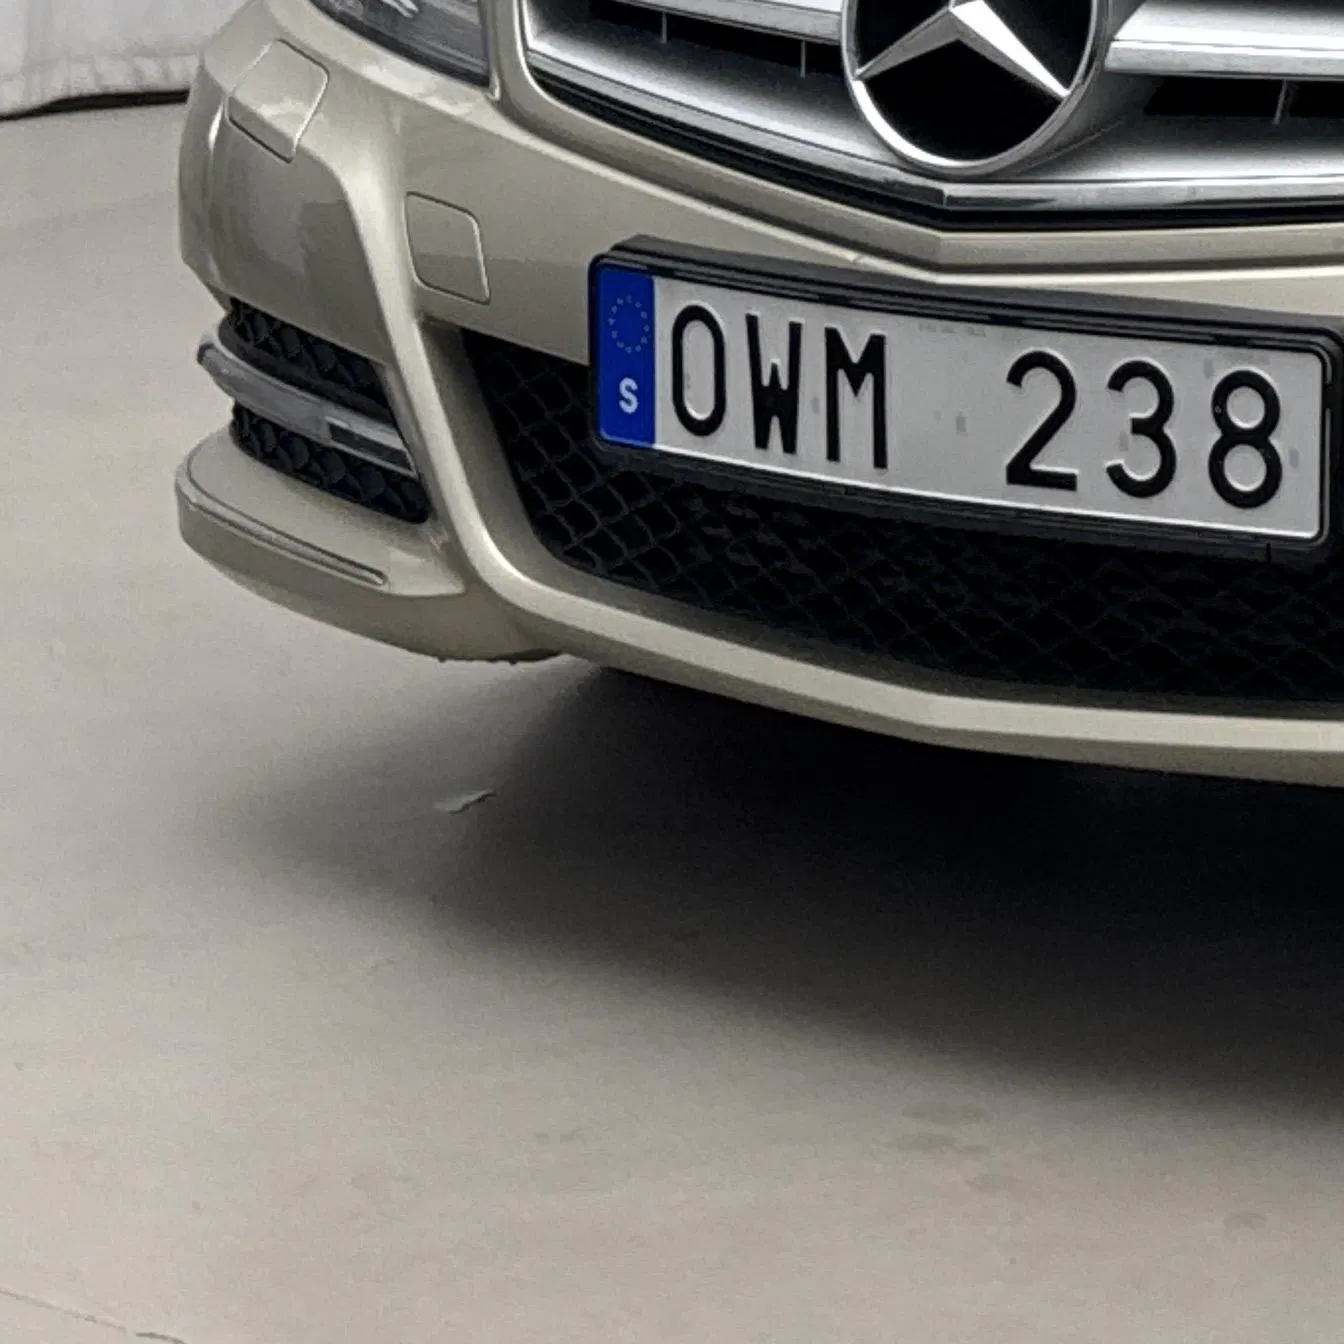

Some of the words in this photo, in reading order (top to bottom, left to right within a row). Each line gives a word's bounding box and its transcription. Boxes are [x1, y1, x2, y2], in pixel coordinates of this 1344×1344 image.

[619, 377, 639, 414] S
[671, 304, 889, 471] OWM
[1006, 350, 1283, 511] 238
